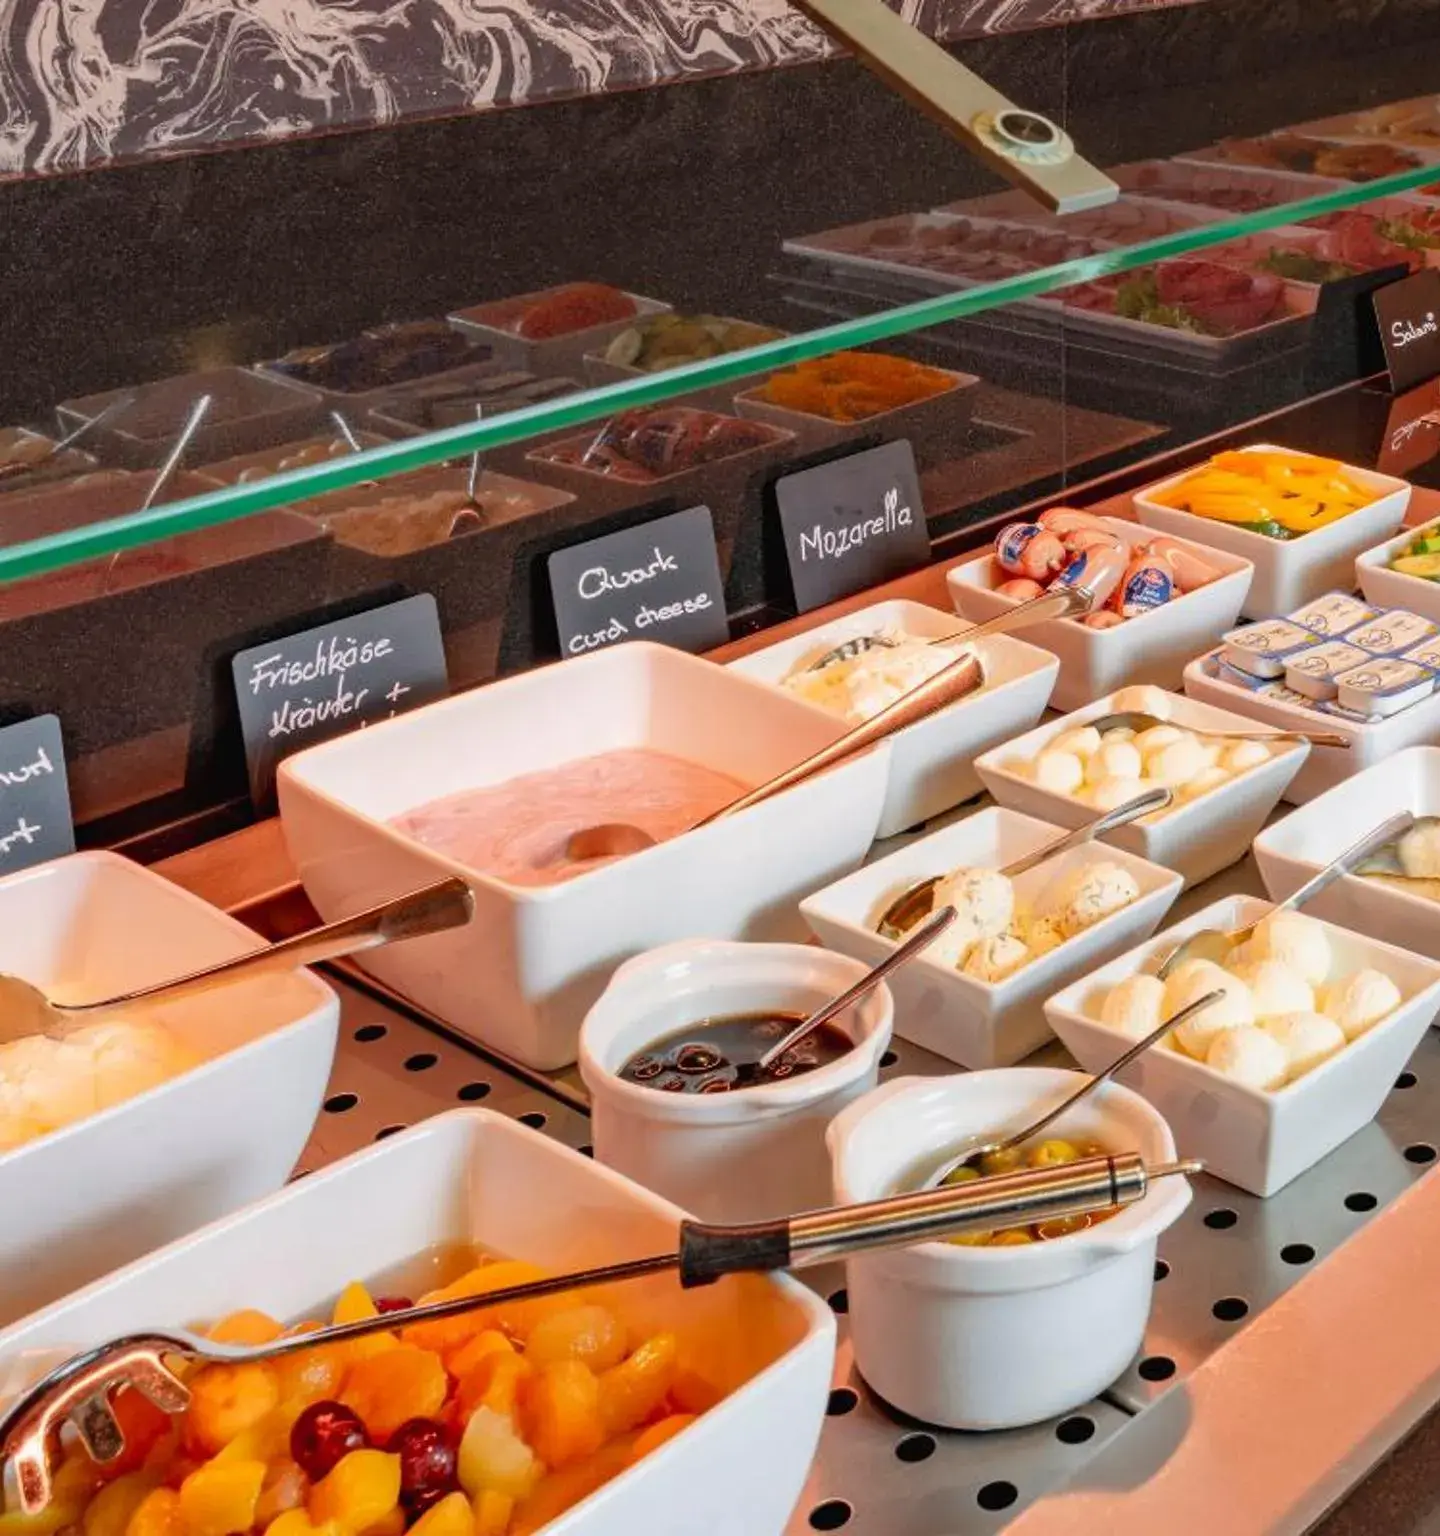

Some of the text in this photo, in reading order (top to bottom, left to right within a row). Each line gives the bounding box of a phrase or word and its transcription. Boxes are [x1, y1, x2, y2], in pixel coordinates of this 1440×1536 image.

[1391, 311, 1438, 347] Salami
[799, 486, 914, 562] Mozarella
[577, 546, 680, 600] Quark
[568, 592, 714, 653] curd cheese
[249, 635, 395, 696] Frischkäse
[267, 673, 371, 739] Kräuter
